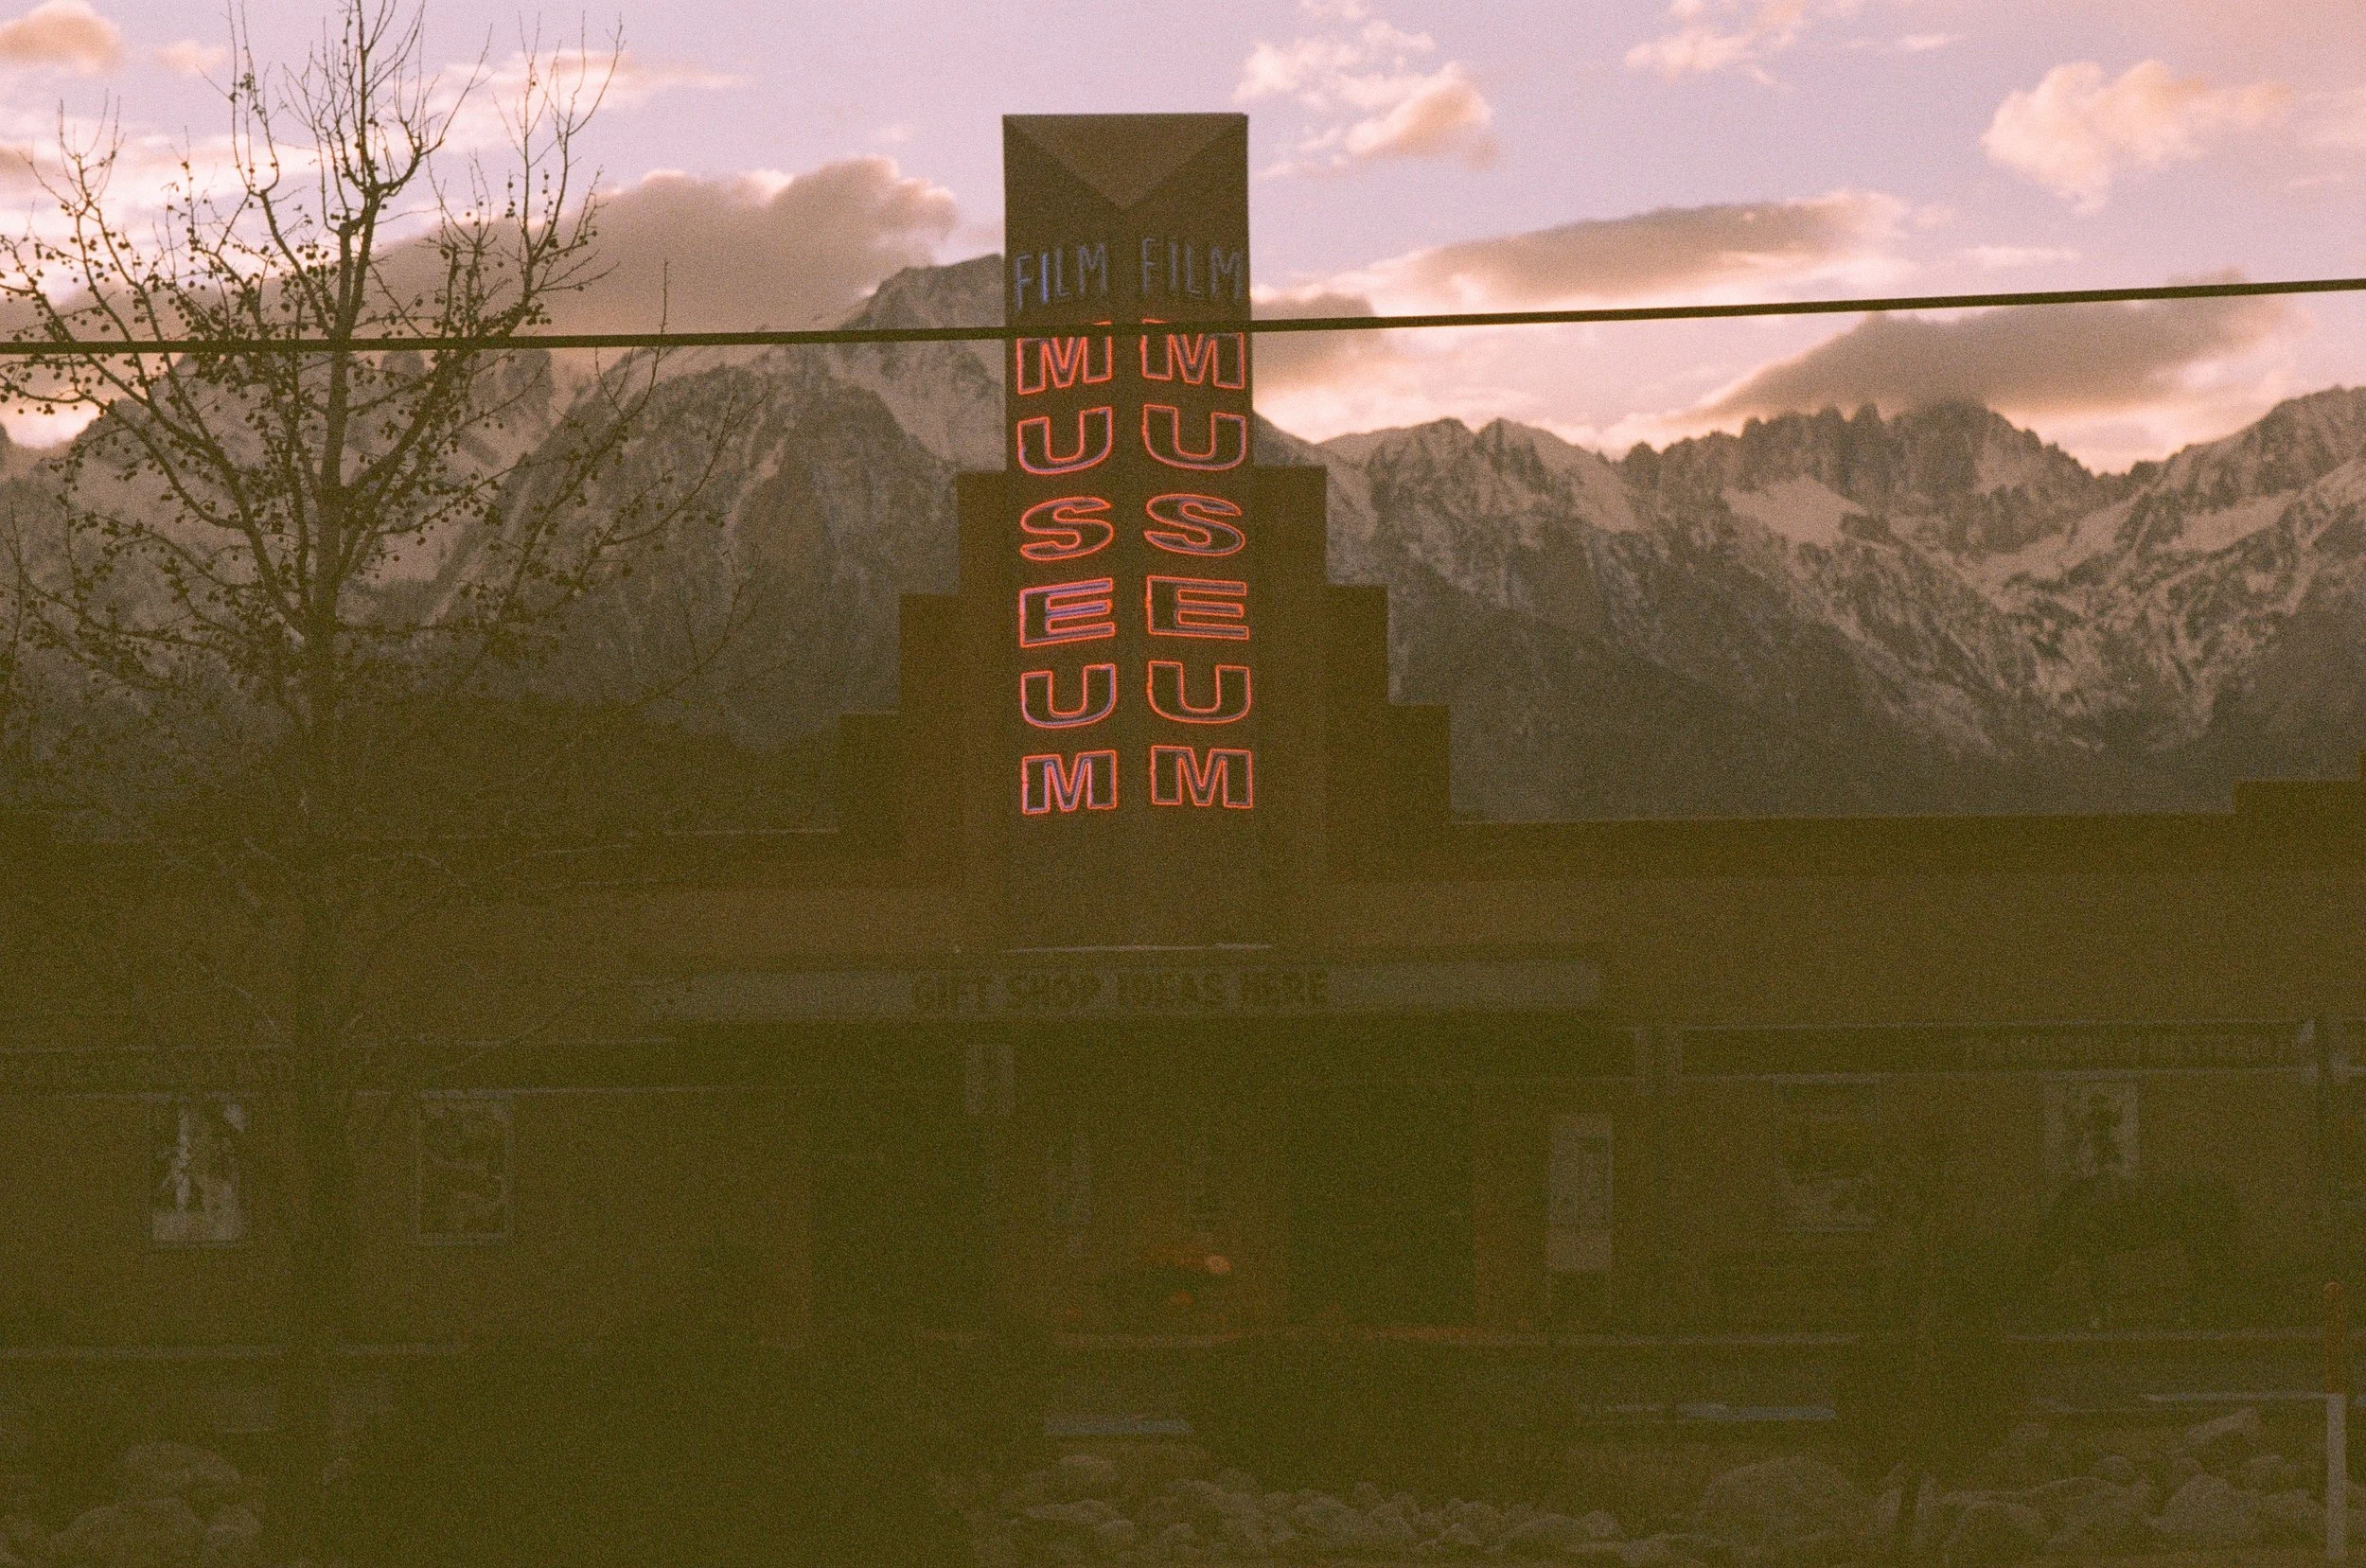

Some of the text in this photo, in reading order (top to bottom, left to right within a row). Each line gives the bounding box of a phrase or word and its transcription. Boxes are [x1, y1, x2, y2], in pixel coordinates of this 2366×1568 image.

[1015, 242, 1108, 311] FILM
[1140, 238, 1244, 300] FILM
[1016, 320, 1117, 815] MUSEUM
[1139, 318, 1254, 809] MUSEUM
[911, 975, 993, 1011] GIFT
[1005, 973, 1103, 1011] SHOP
[1239, 970, 1329, 1008] HERE
